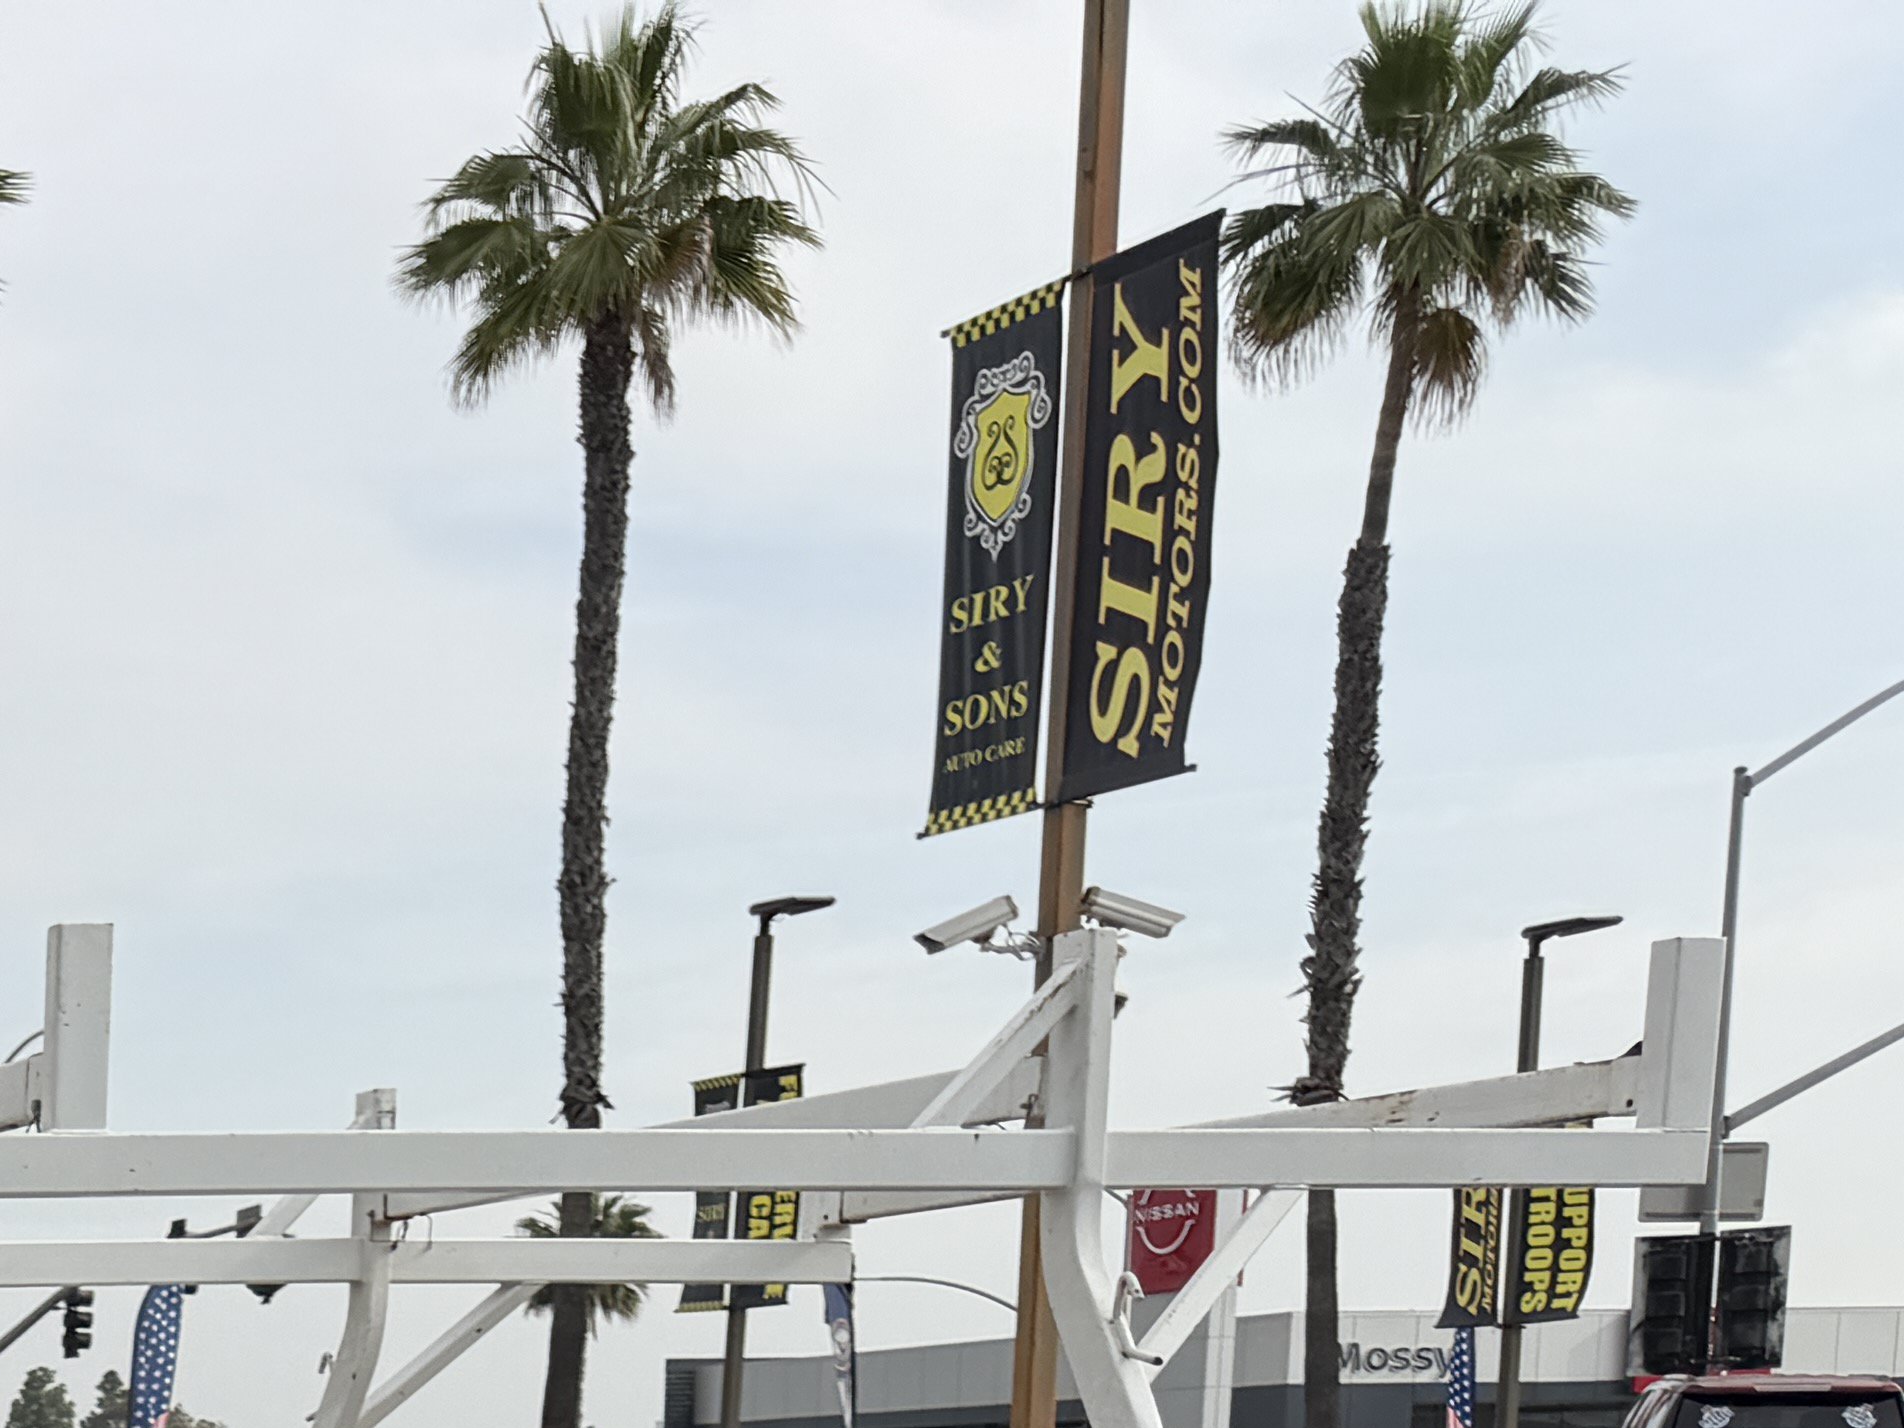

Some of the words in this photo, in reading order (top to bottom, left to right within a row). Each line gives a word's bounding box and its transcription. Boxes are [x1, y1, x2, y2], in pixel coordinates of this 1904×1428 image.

[1090, 282, 1171, 760] SIRY
[1151, 258, 1204, 748] MOTORS.COM
[949, 574, 1035, 634] SIRY
[974, 641, 1002, 673] &
[944, 680, 1029, 737] SONS
[943, 748, 983, 773] AUTO
[984, 737, 1026, 763] CARE
[1135, 1201, 1200, 1223] NISSAN
[1456, 1188, 1485, 1316] SIR
[1550, 1188, 1589, 1313] UPPORT
